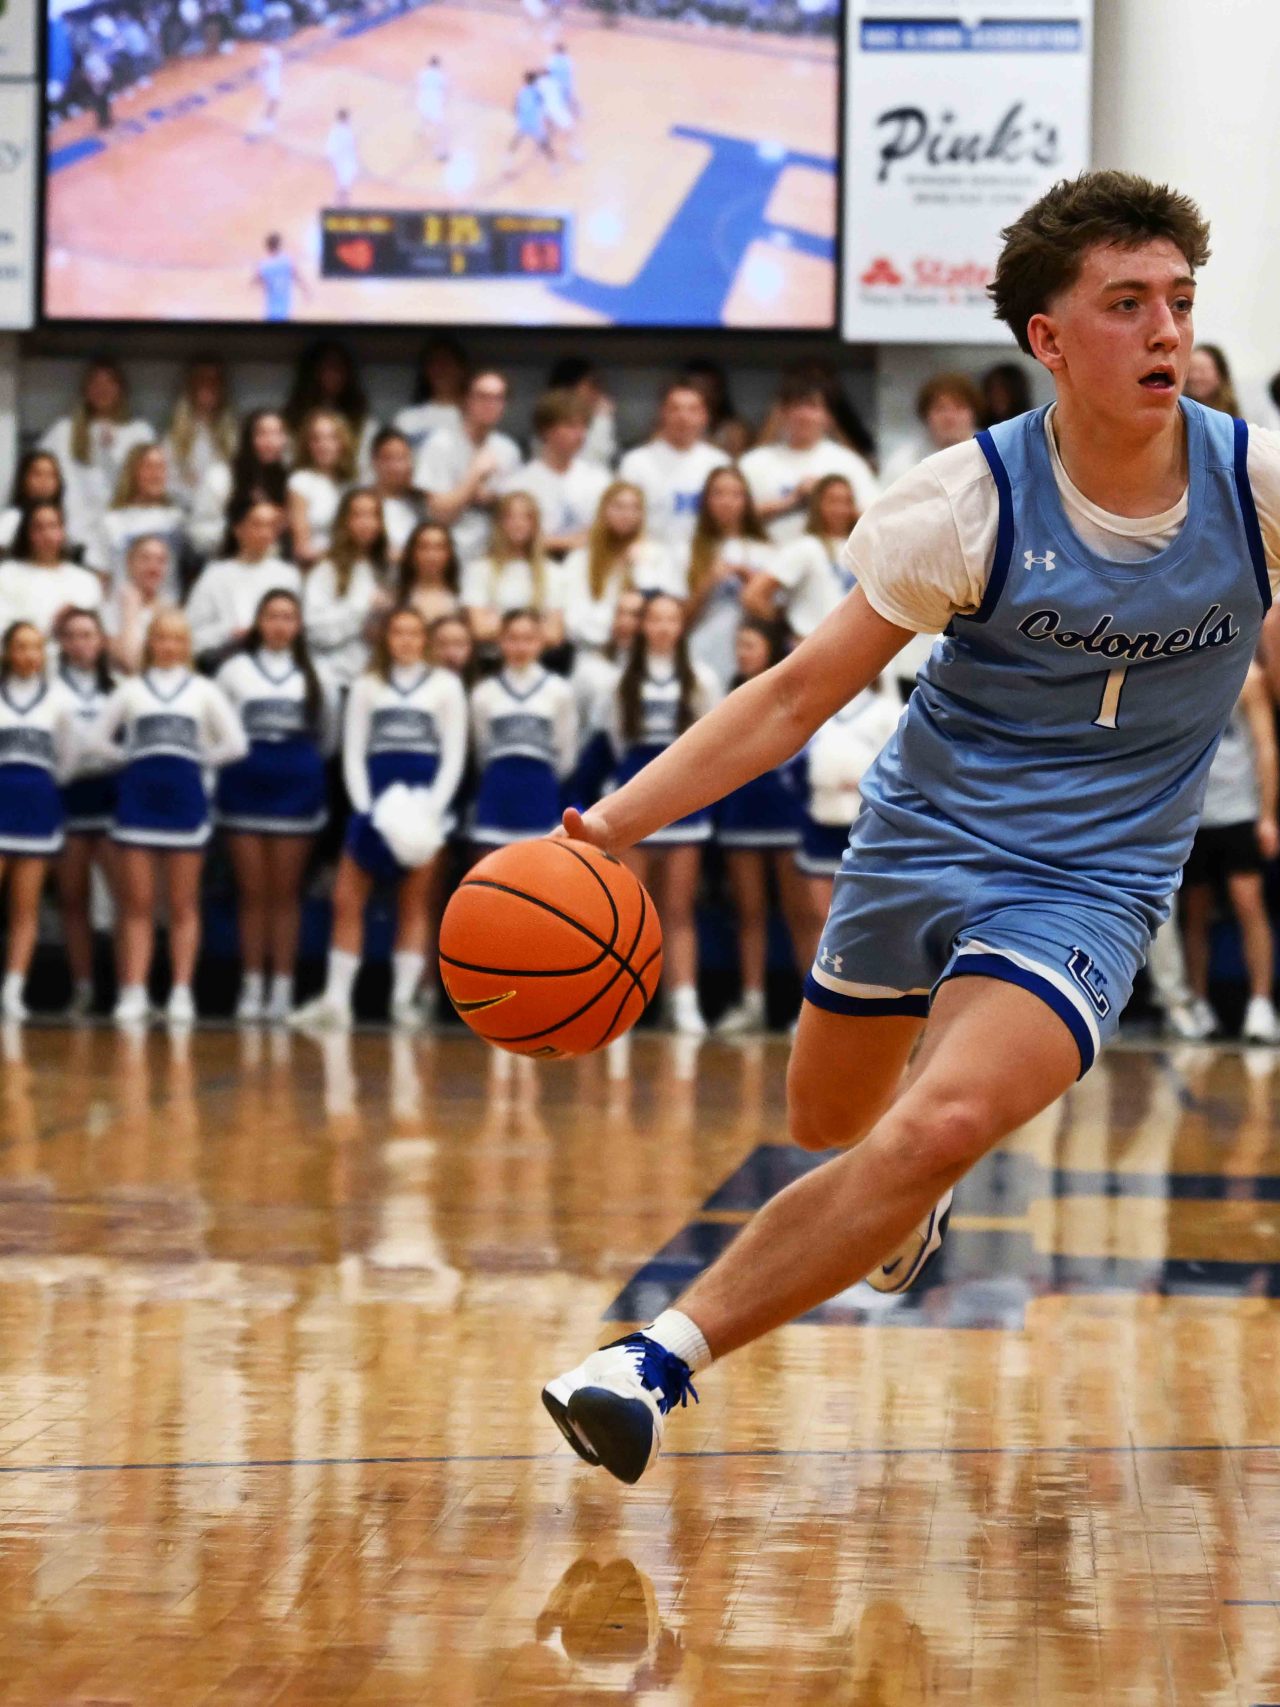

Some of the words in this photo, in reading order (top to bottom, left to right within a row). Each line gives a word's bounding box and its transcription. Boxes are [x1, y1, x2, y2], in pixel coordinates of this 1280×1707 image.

[876, 101, 1060, 183] Pink's
[1016, 603, 1240, 661] Colonels
[1090, 665, 1129, 731] 1
